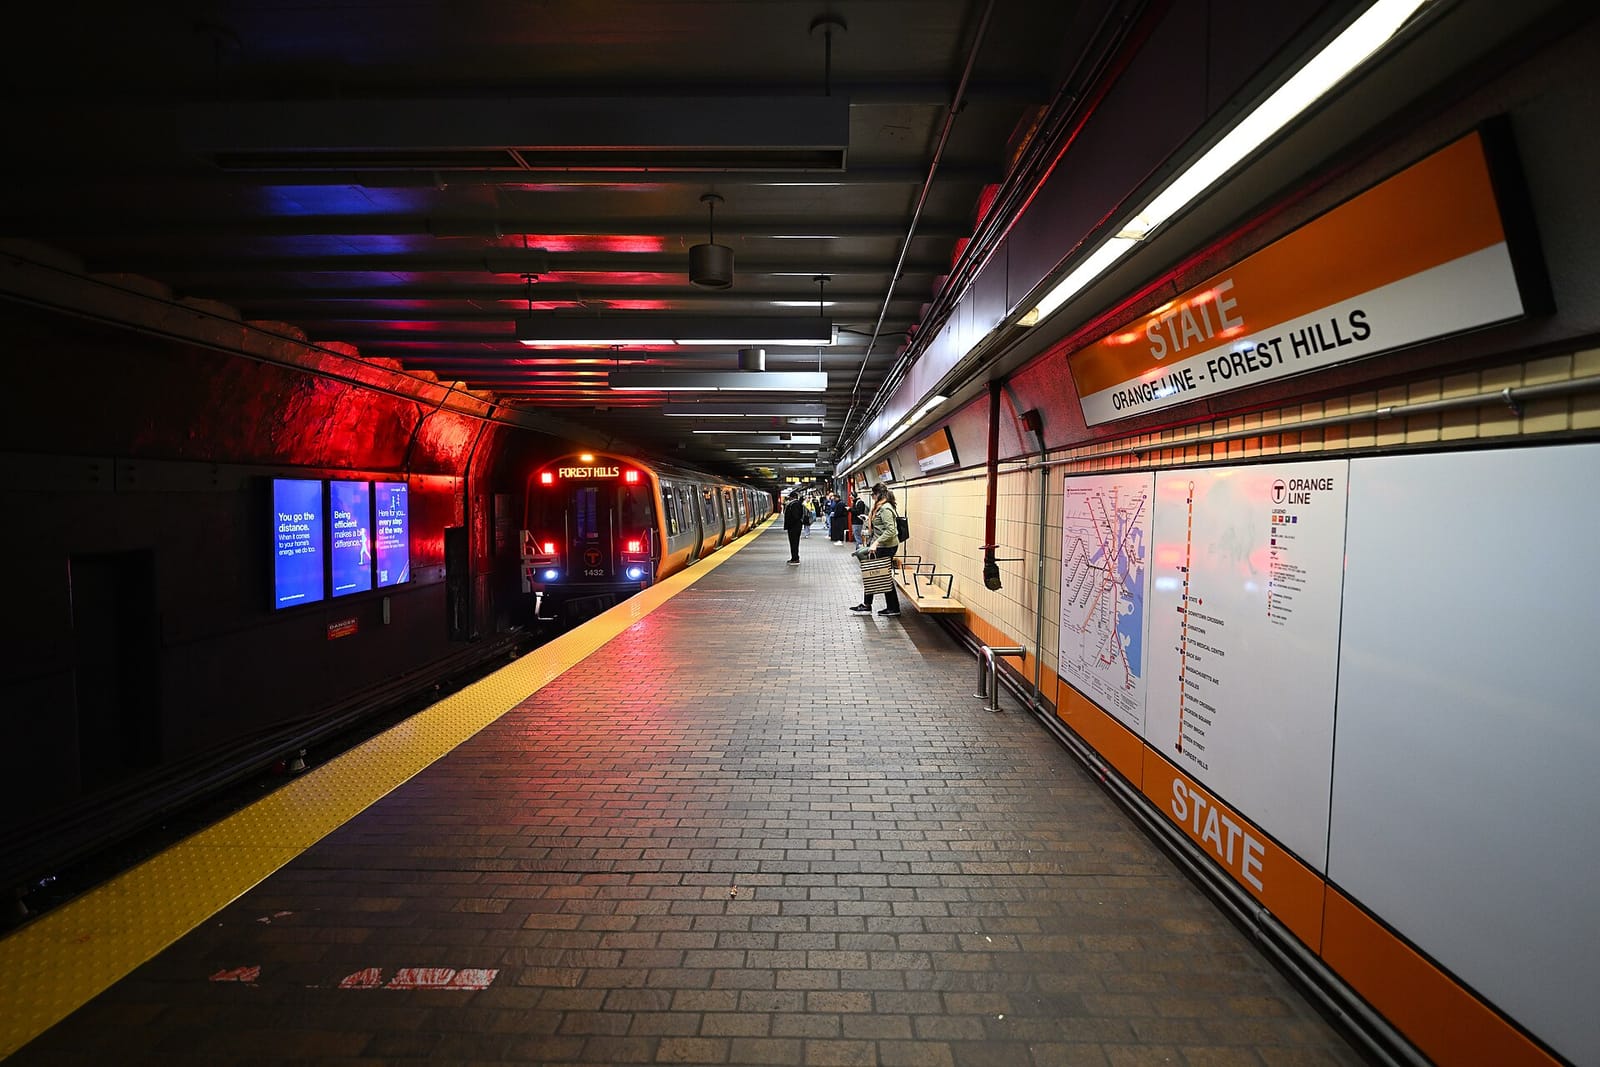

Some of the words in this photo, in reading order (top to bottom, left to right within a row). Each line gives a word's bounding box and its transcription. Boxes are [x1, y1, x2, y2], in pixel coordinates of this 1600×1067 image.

[1146, 278, 1244, 361] STATE
[1112, 380, 1159, 411] ORANGE
[1161, 368, 1196, 397] LINE
[1207, 337, 1283, 383] FOREST
[1289, 309, 1371, 358] HILLS
[559, 467, 592, 478] FOREST
[593, 466, 620, 477] HILLS
[1288, 478, 1334, 491] ORANGE
[1288, 492, 1311, 504] LINE
[278, 512, 293, 521] You
[293, 513, 303, 523] go
[303, 511, 315, 521] the
[334, 510, 351, 520] Being
[278, 523, 310, 532] distance.
[334, 519, 358, 528] efficient
[378, 519, 391, 527] every
[392, 518, 403, 526] step
[334, 530, 353, 539] makes
[1171, 778, 1265, 892] STATE
